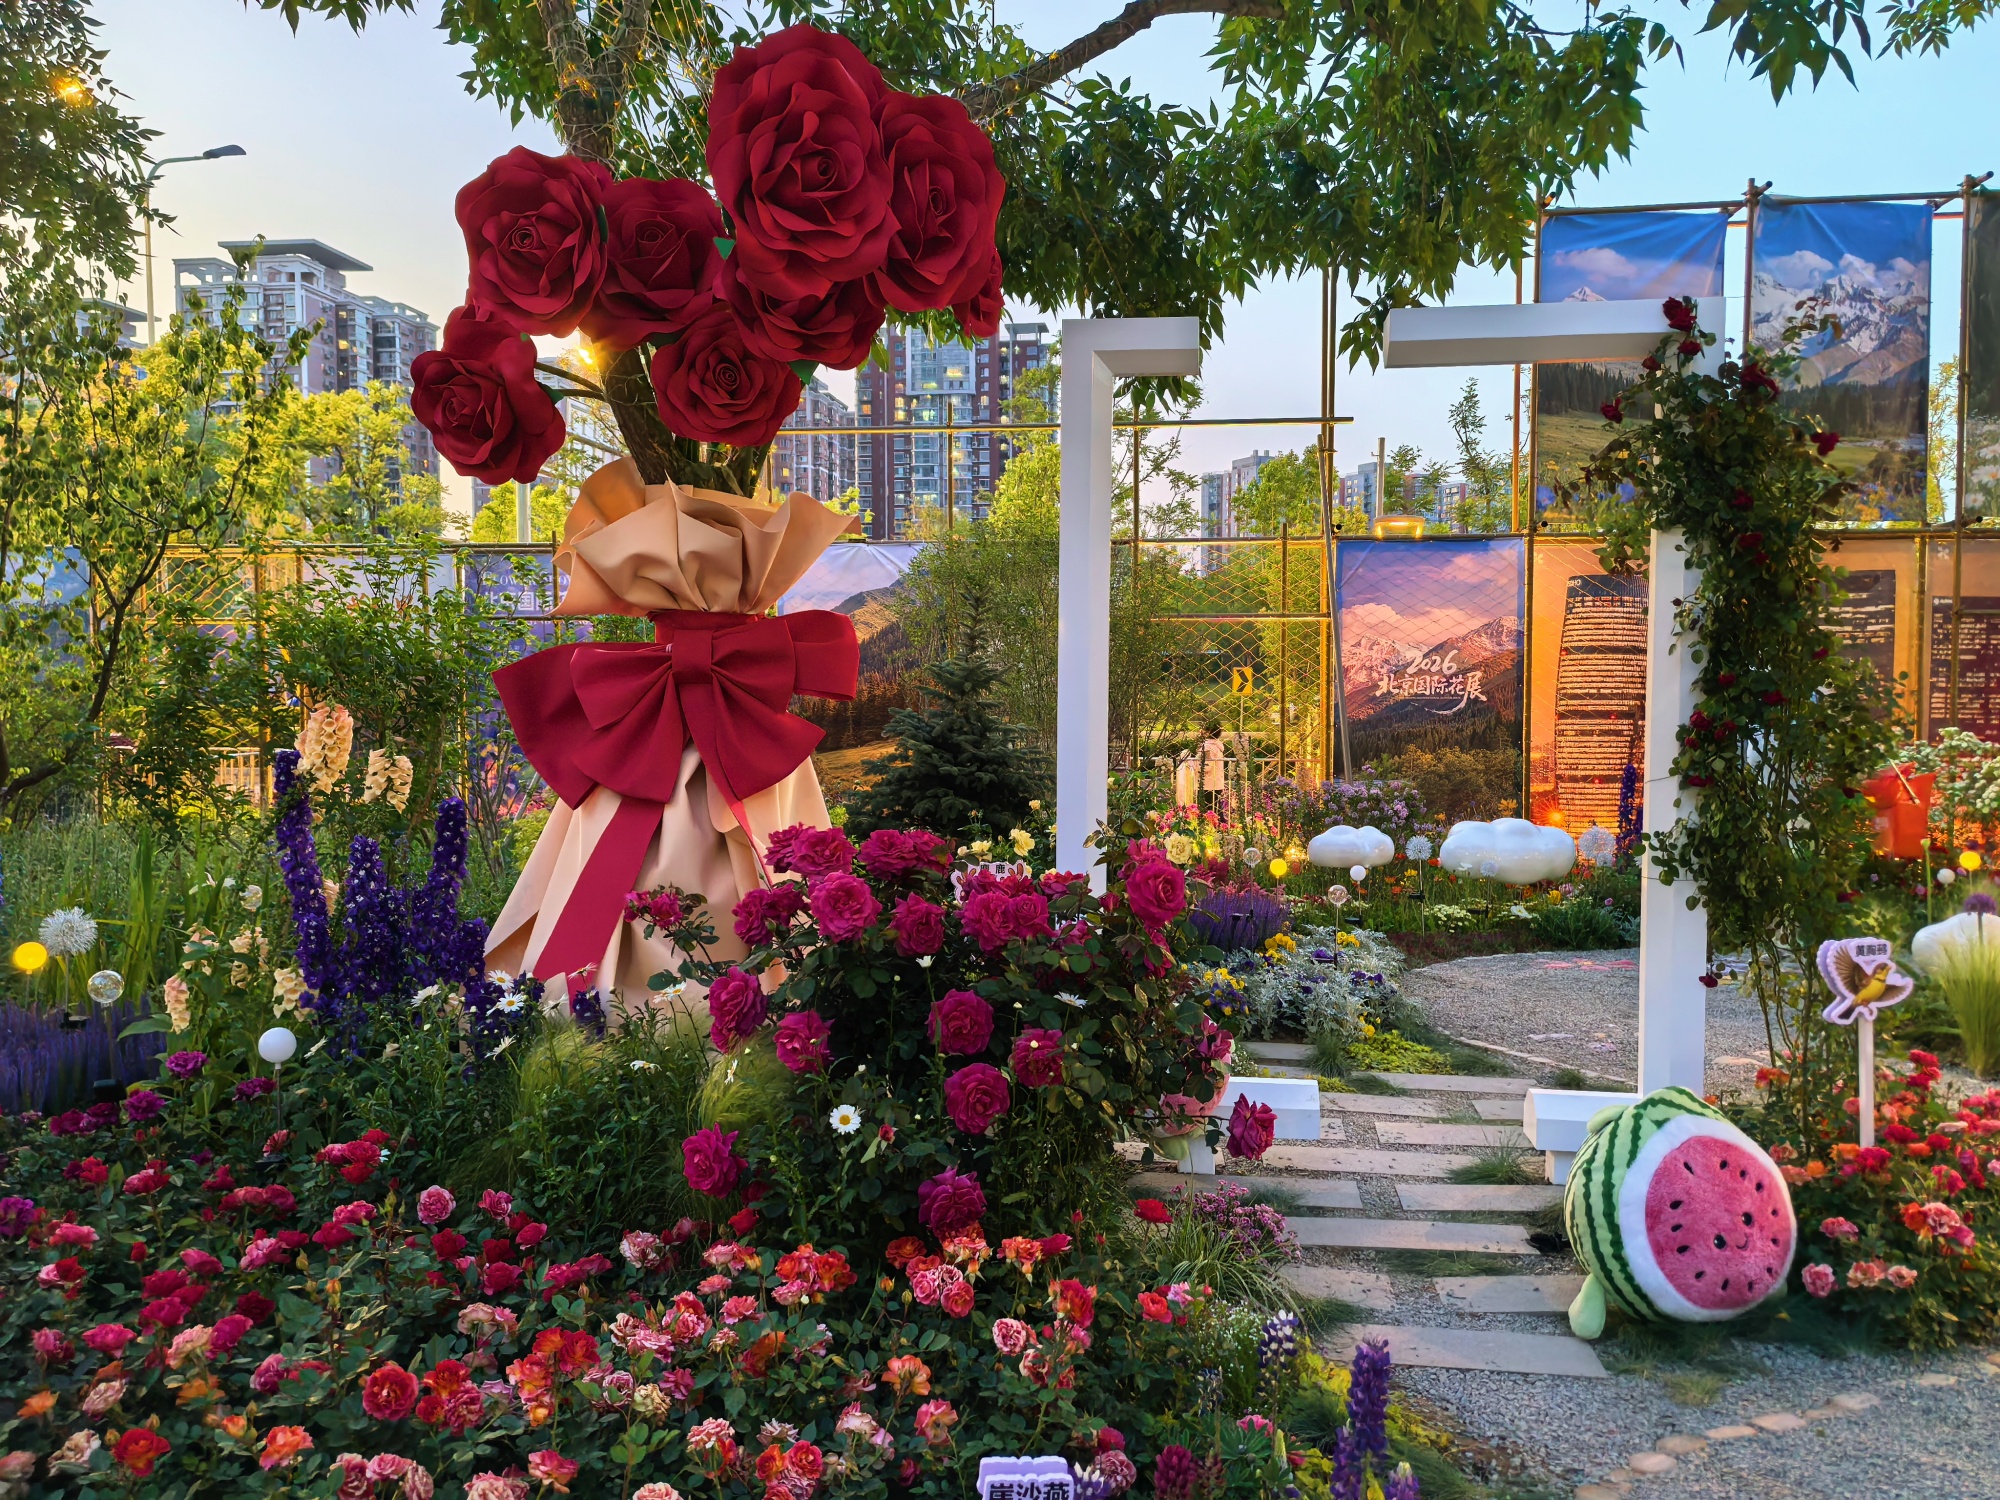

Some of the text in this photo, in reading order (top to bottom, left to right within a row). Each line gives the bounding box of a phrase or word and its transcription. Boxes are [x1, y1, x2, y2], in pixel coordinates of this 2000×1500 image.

[1405, 649, 1459, 675] 2026
[1375, 671, 1488, 715] 北京国际花展
